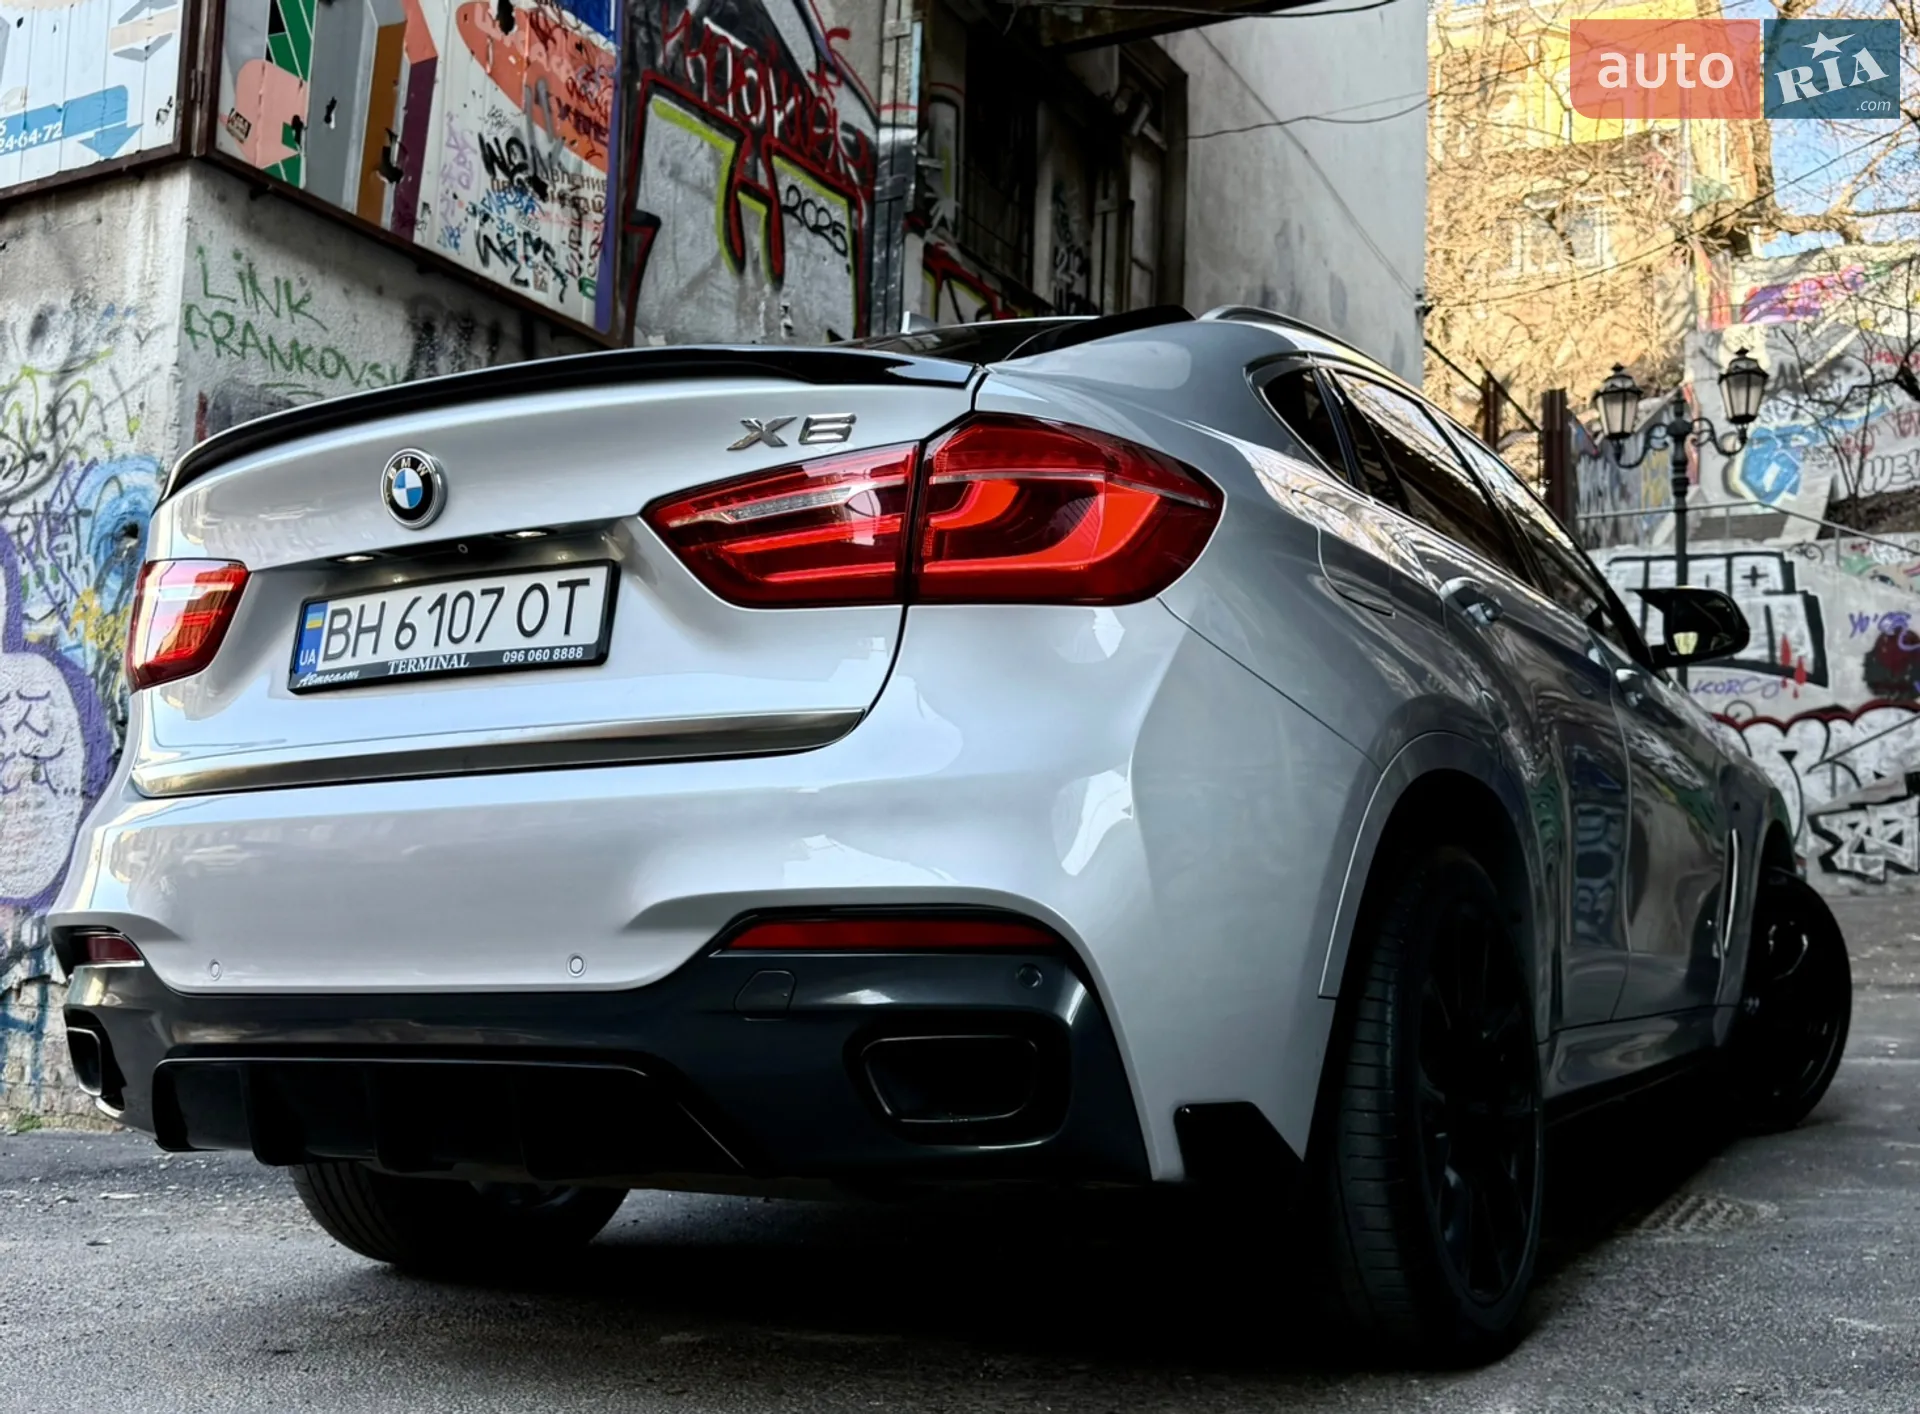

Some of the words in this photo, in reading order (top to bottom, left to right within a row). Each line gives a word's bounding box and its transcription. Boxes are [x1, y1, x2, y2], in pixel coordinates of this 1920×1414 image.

[780, 184, 849, 257] 2025
[726, 412, 857, 451] X6
[387, 457, 430, 480] BMW
[322, 600, 386, 662] BH
[394, 586, 505, 651] 6107
[516, 578, 591, 638] OT
[299, 648, 316, 666] UA
[387, 653, 470, 675] TERMINAL
[502, 650, 525, 663] 096
[527, 649, 550, 662] 060
[552, 646, 584, 660] 8888
